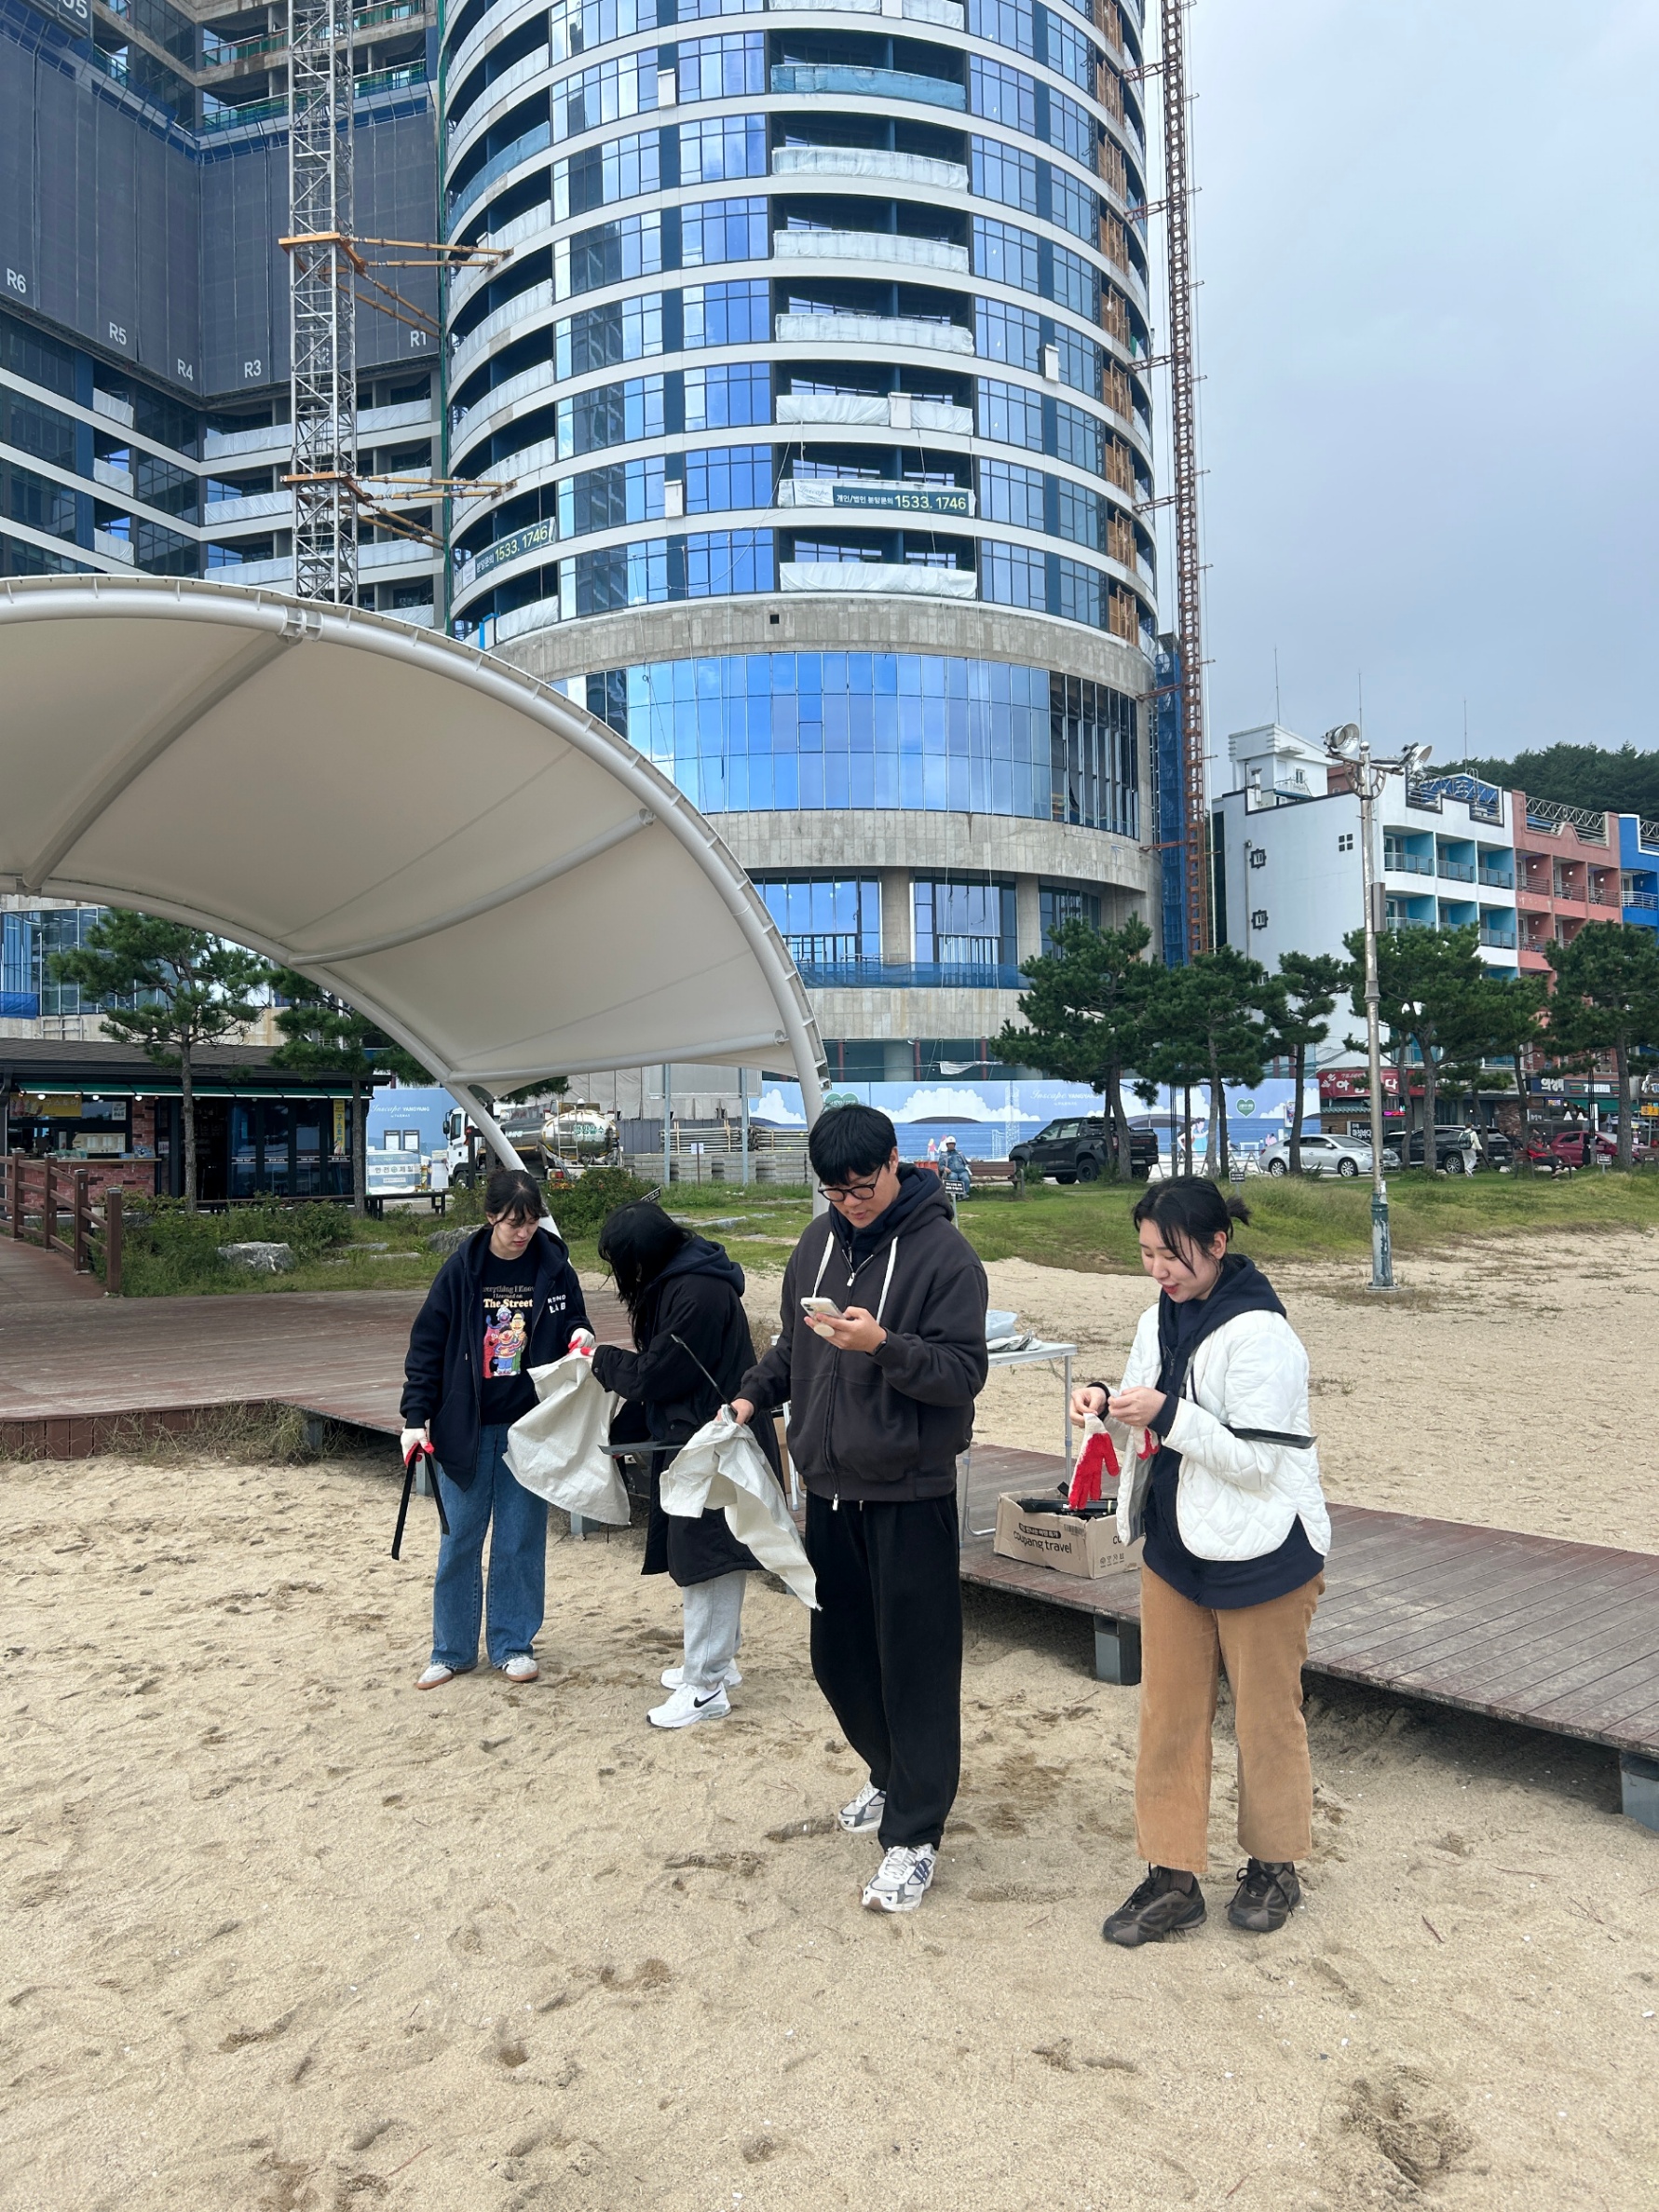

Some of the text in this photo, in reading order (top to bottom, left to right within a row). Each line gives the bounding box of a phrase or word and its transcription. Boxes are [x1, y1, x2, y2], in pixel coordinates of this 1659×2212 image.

[7, 267, 27, 293] R6
[109, 321, 127, 346] R5
[410, 331, 427, 347] R1
[177, 359, 194, 381] R4
[244, 360, 262, 378] R3
[935, 496, 967, 510] 1746
[522, 525, 548, 549] 1746
[483, 1298, 534, 1309] The Street
[549, 1302, 566, 1314] LAB
[1013, 1530, 1072, 1554] coupang travel
